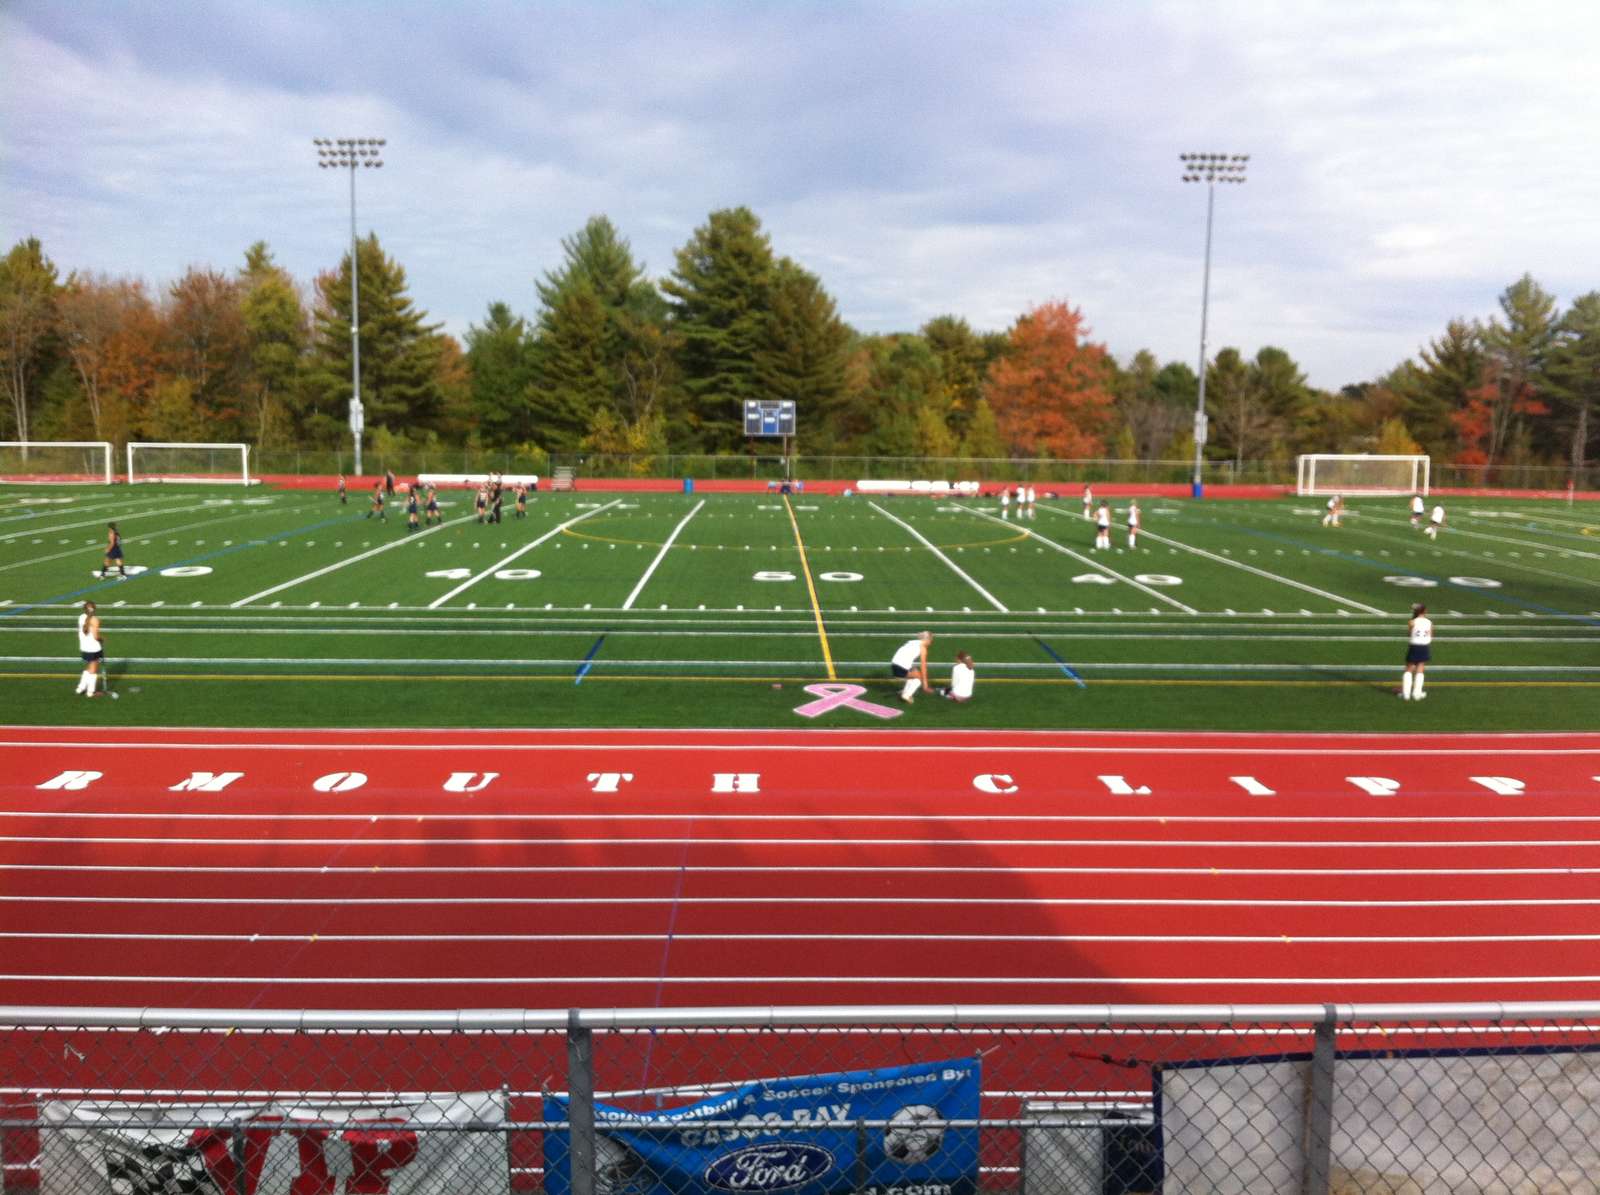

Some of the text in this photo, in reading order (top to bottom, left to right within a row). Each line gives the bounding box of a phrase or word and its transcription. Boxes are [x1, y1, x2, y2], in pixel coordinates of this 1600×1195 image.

[763, 1083, 832, 1101] Soccer
[838, 1073, 937, 1094] Sponsored
[729, 1150, 808, 1188] Ford
